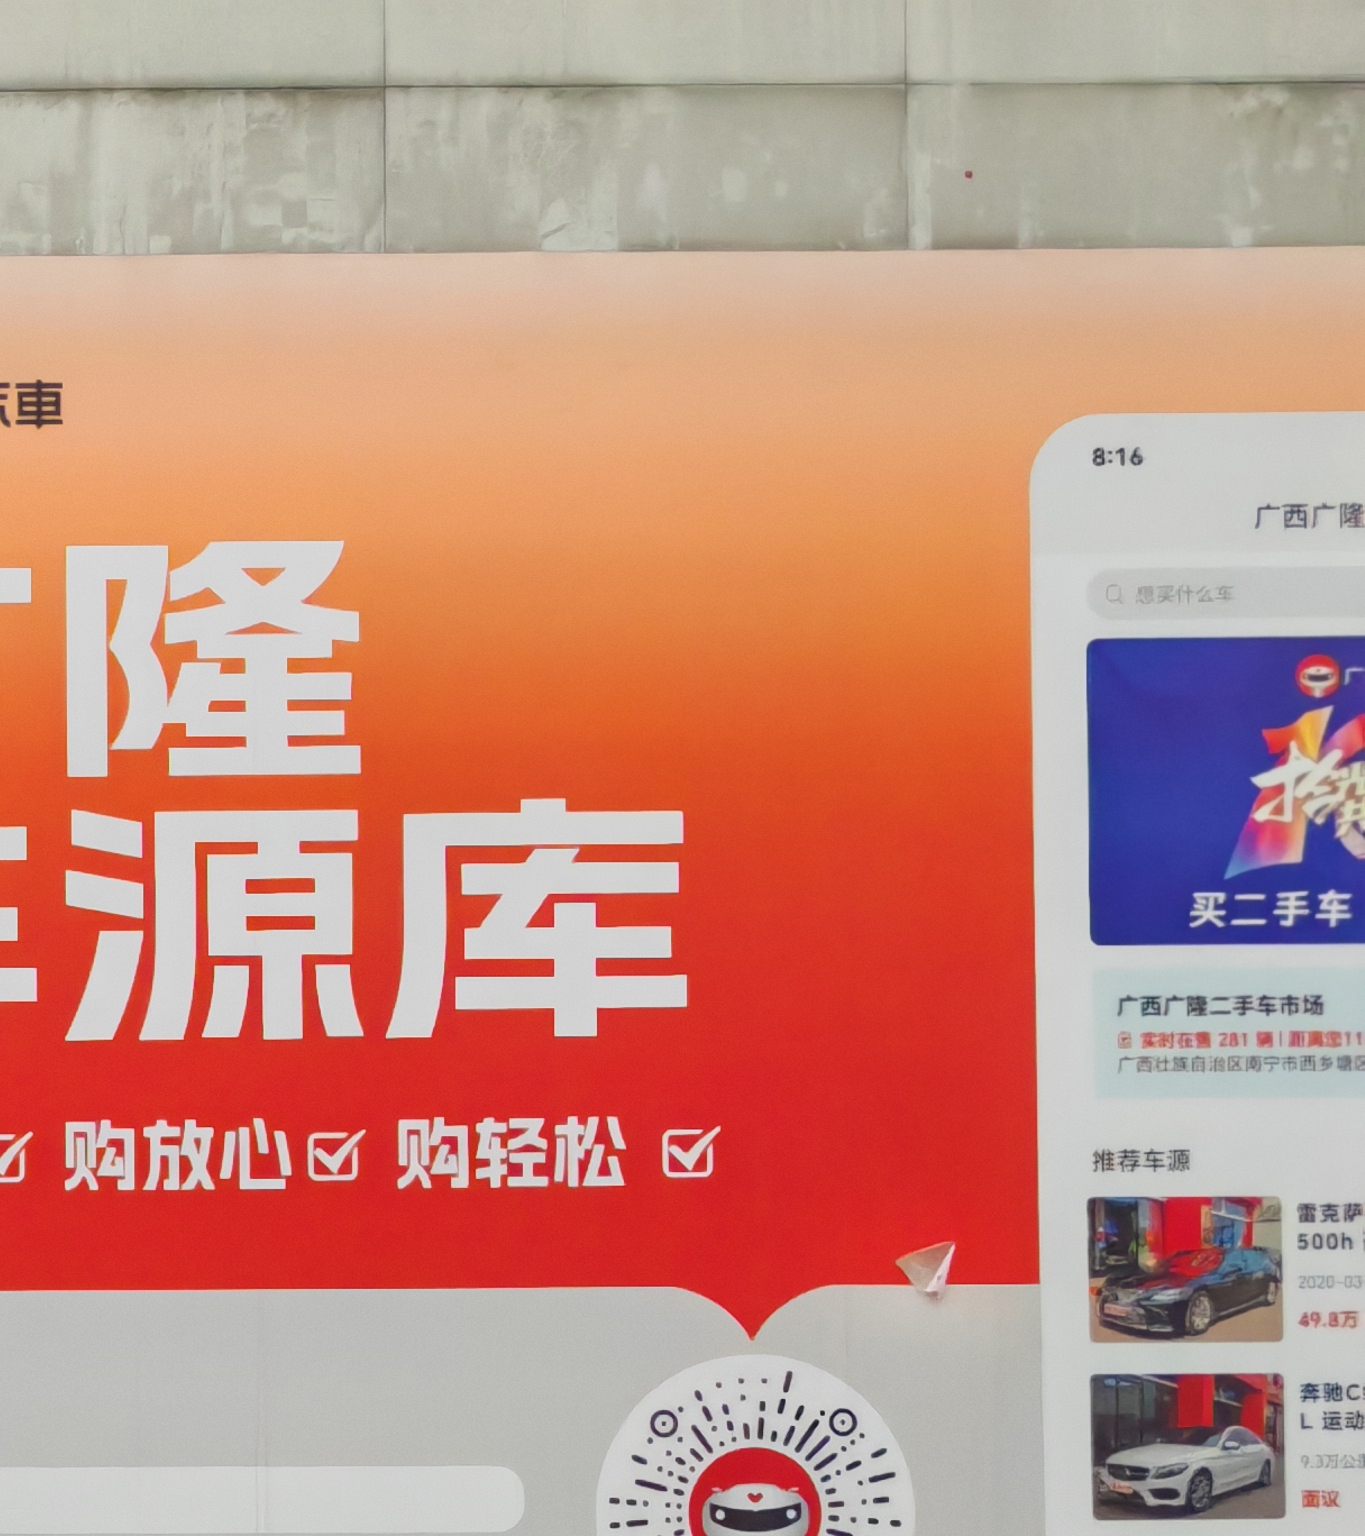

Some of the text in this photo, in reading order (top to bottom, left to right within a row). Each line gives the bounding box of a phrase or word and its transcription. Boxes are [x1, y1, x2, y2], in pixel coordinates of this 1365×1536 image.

[1092, 447, 1144, 466] 8:16
[1189, 889, 1353, 928] 买二手车
[1117, 995, 1324, 1016] 广西广隆二手车市场
[64, 1119, 291, 1192] 购放心
[396, 1118, 626, 1190] 购轻松
[1093, 1149, 1190, 1172] 推荐车源
[1297, 1203, 1363, 1223] 雷克萨
[1297, 1232, 1353, 1250] 500h
[1300, 1383, 1365, 1402] 奔驰C
